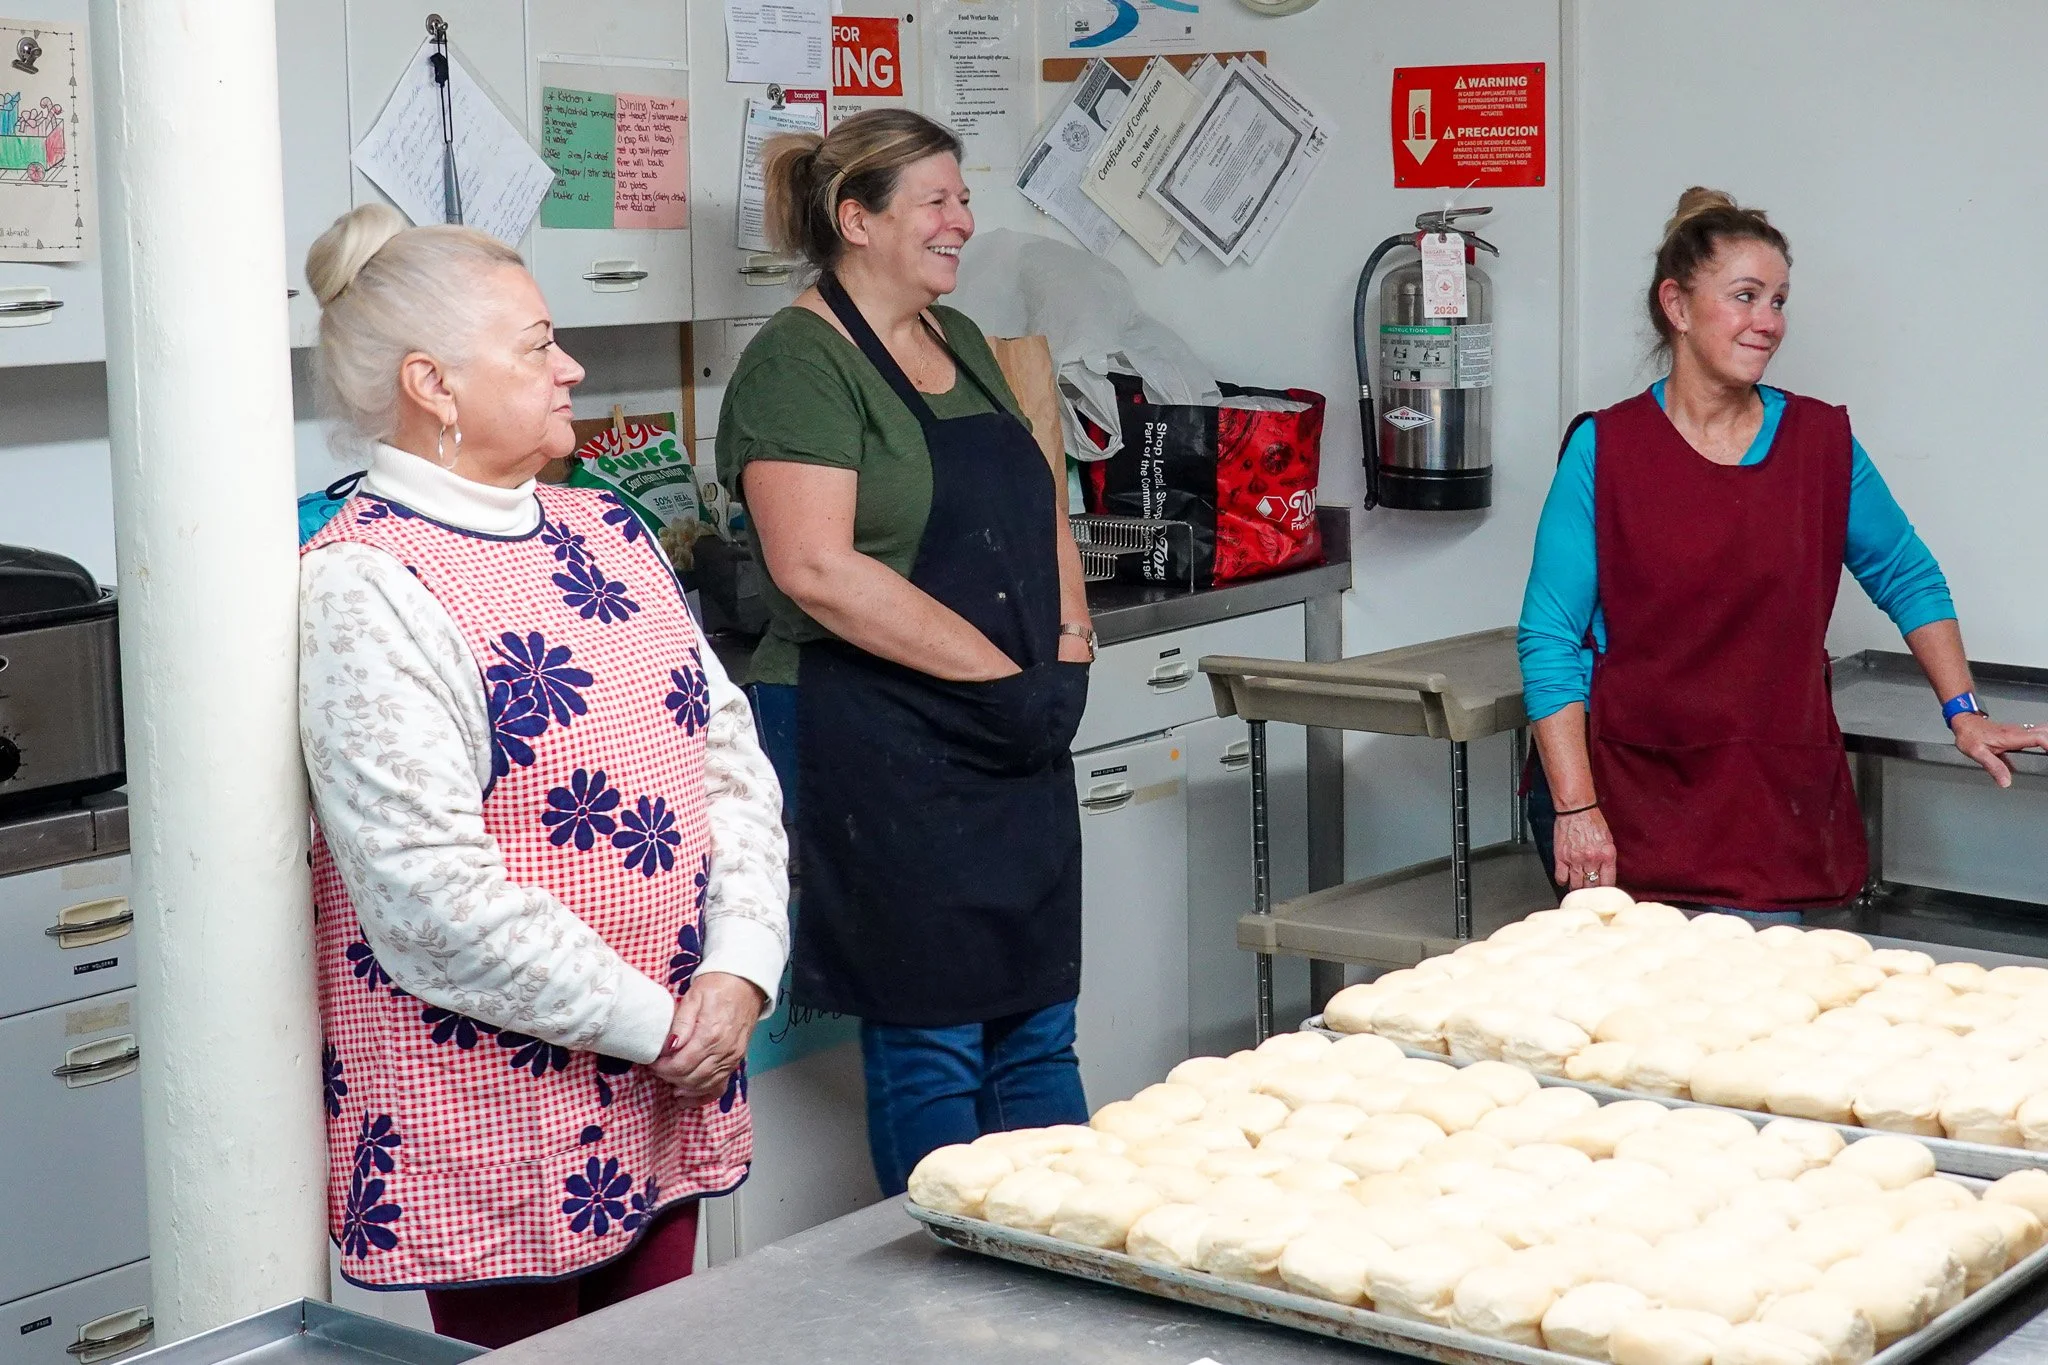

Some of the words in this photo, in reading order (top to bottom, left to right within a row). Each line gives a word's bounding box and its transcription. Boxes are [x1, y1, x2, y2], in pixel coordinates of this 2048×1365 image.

[832, 26, 860, 42] FOR
[832, 47, 894, 88] ING
[1468, 76, 1527, 88] WARNING
[558, 91, 583, 104] Kitchen
[618, 98, 648, 115] Dining
[650, 100, 668, 110] Room
[849, 104, 862, 112] signs
[634, 123, 650, 132] down
[653, 123, 671, 132] tables
[1097, 136, 1129, 179] Certificate
[1129, 78, 1164, 127] Completion
[1458, 126, 1538, 138] PRECAUCION
[1130, 150, 1145, 168] Don
[1141, 123, 1161, 150] Mahar
[1156, 145, 1171, 165] SAFETY
[1168, 121, 1185, 145] COURSE
[553, 189, 574, 200] butter
[1434, 306, 1458, 314] 2020
[1145, 422, 1154, 444] Part
[1153, 422, 1168, 456] Shop
[597, 438, 682, 478] PUFFS
[1144, 446, 1150, 458] of
[1140, 460, 1150, 476] the
[1153, 460, 1166, 489] Local.
[626, 480, 642, 492] Sour
[638, 474, 659, 484] Cream
[660, 467, 684, 479] Onion
[653, 496, 672, 506] 30%
[674, 494, 692, 502] REAL
[1153, 492, 1167, 520] Shop
